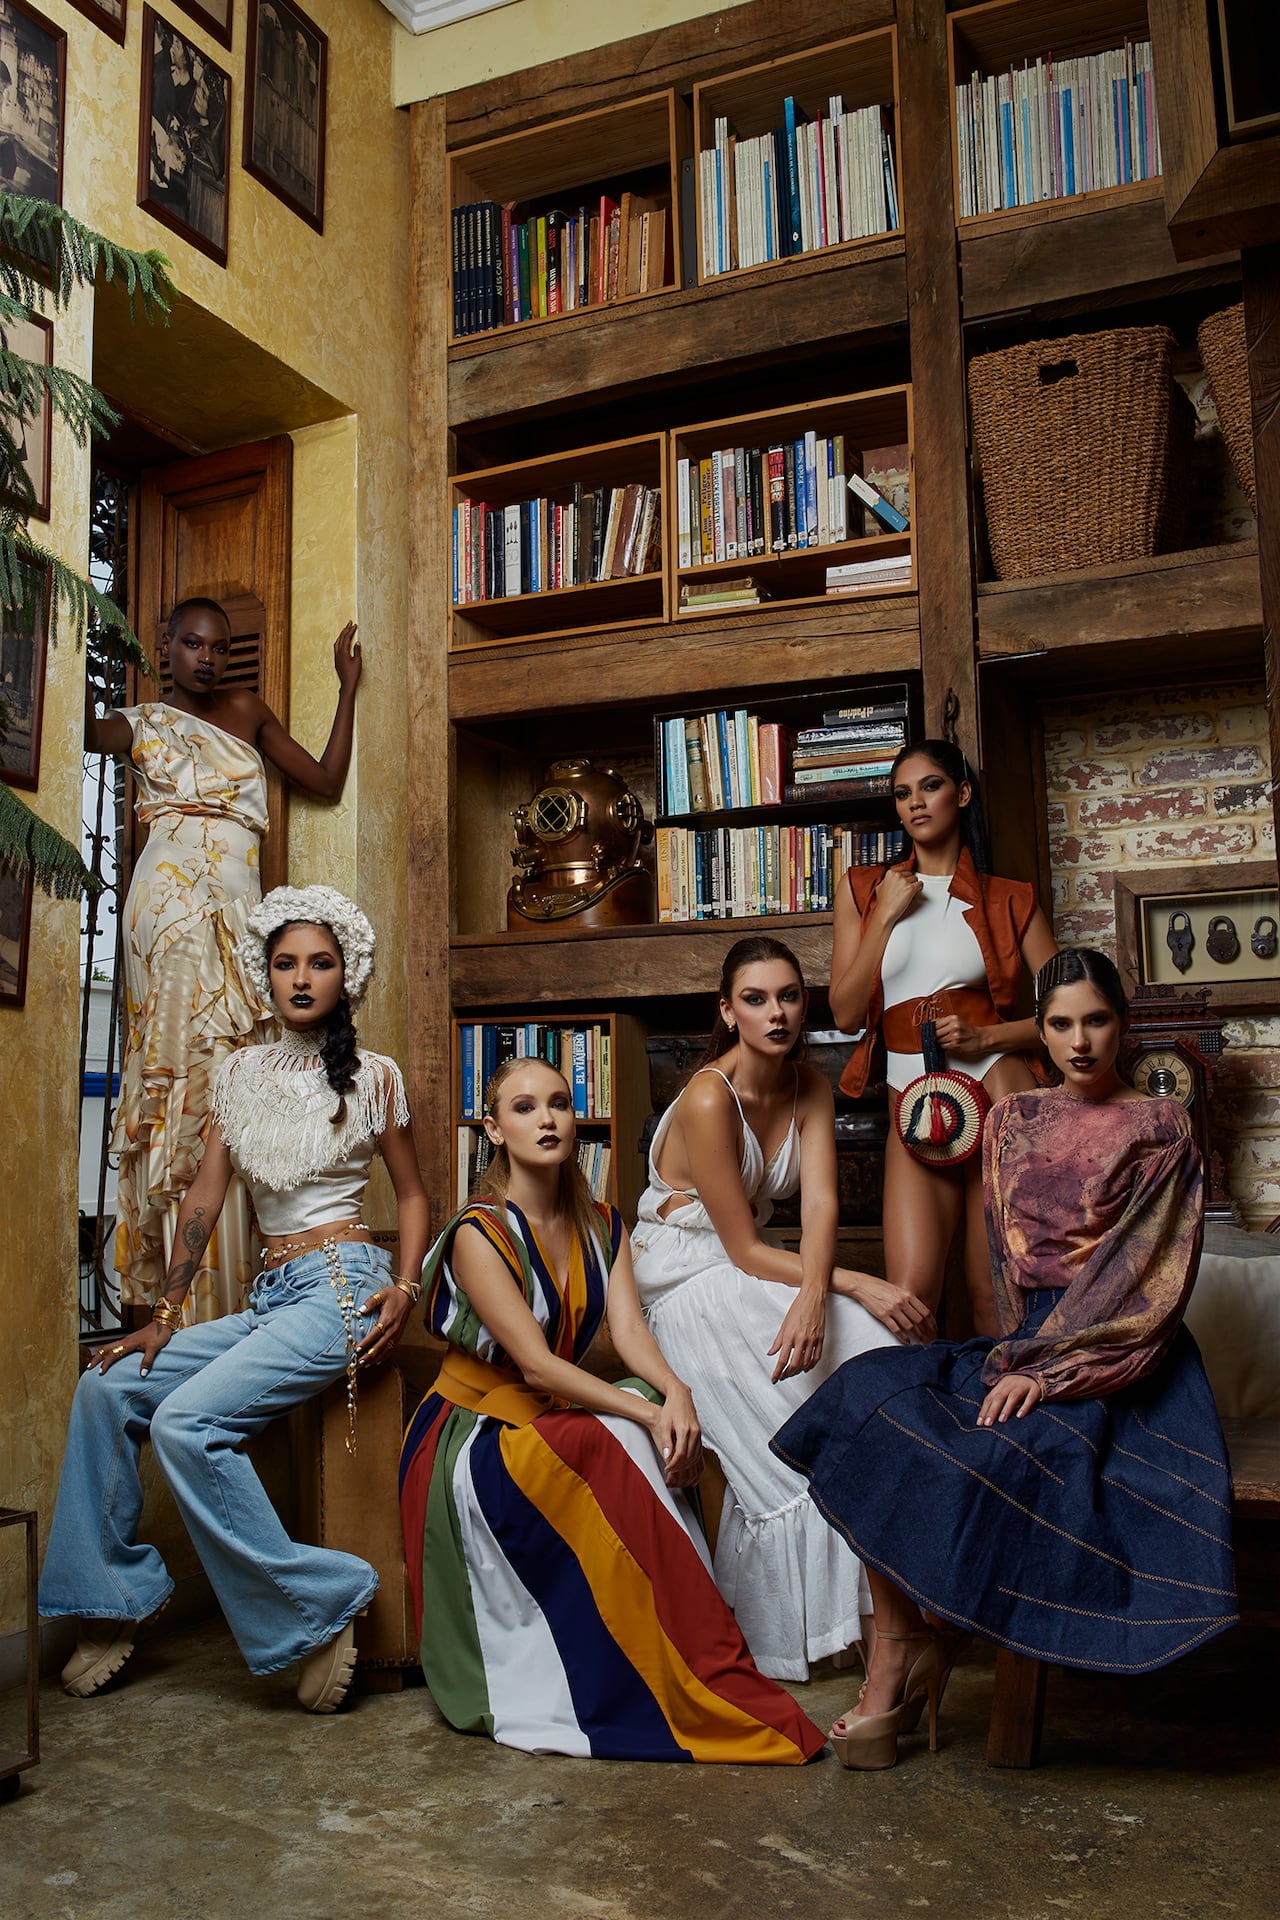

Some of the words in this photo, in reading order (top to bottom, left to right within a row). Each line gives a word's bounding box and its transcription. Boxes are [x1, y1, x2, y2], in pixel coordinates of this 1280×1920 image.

[838, 707, 867, 719] Padrino
[575, 1033, 586, 1072] VIAJERO
[575, 1072, 585, 1085] EL
